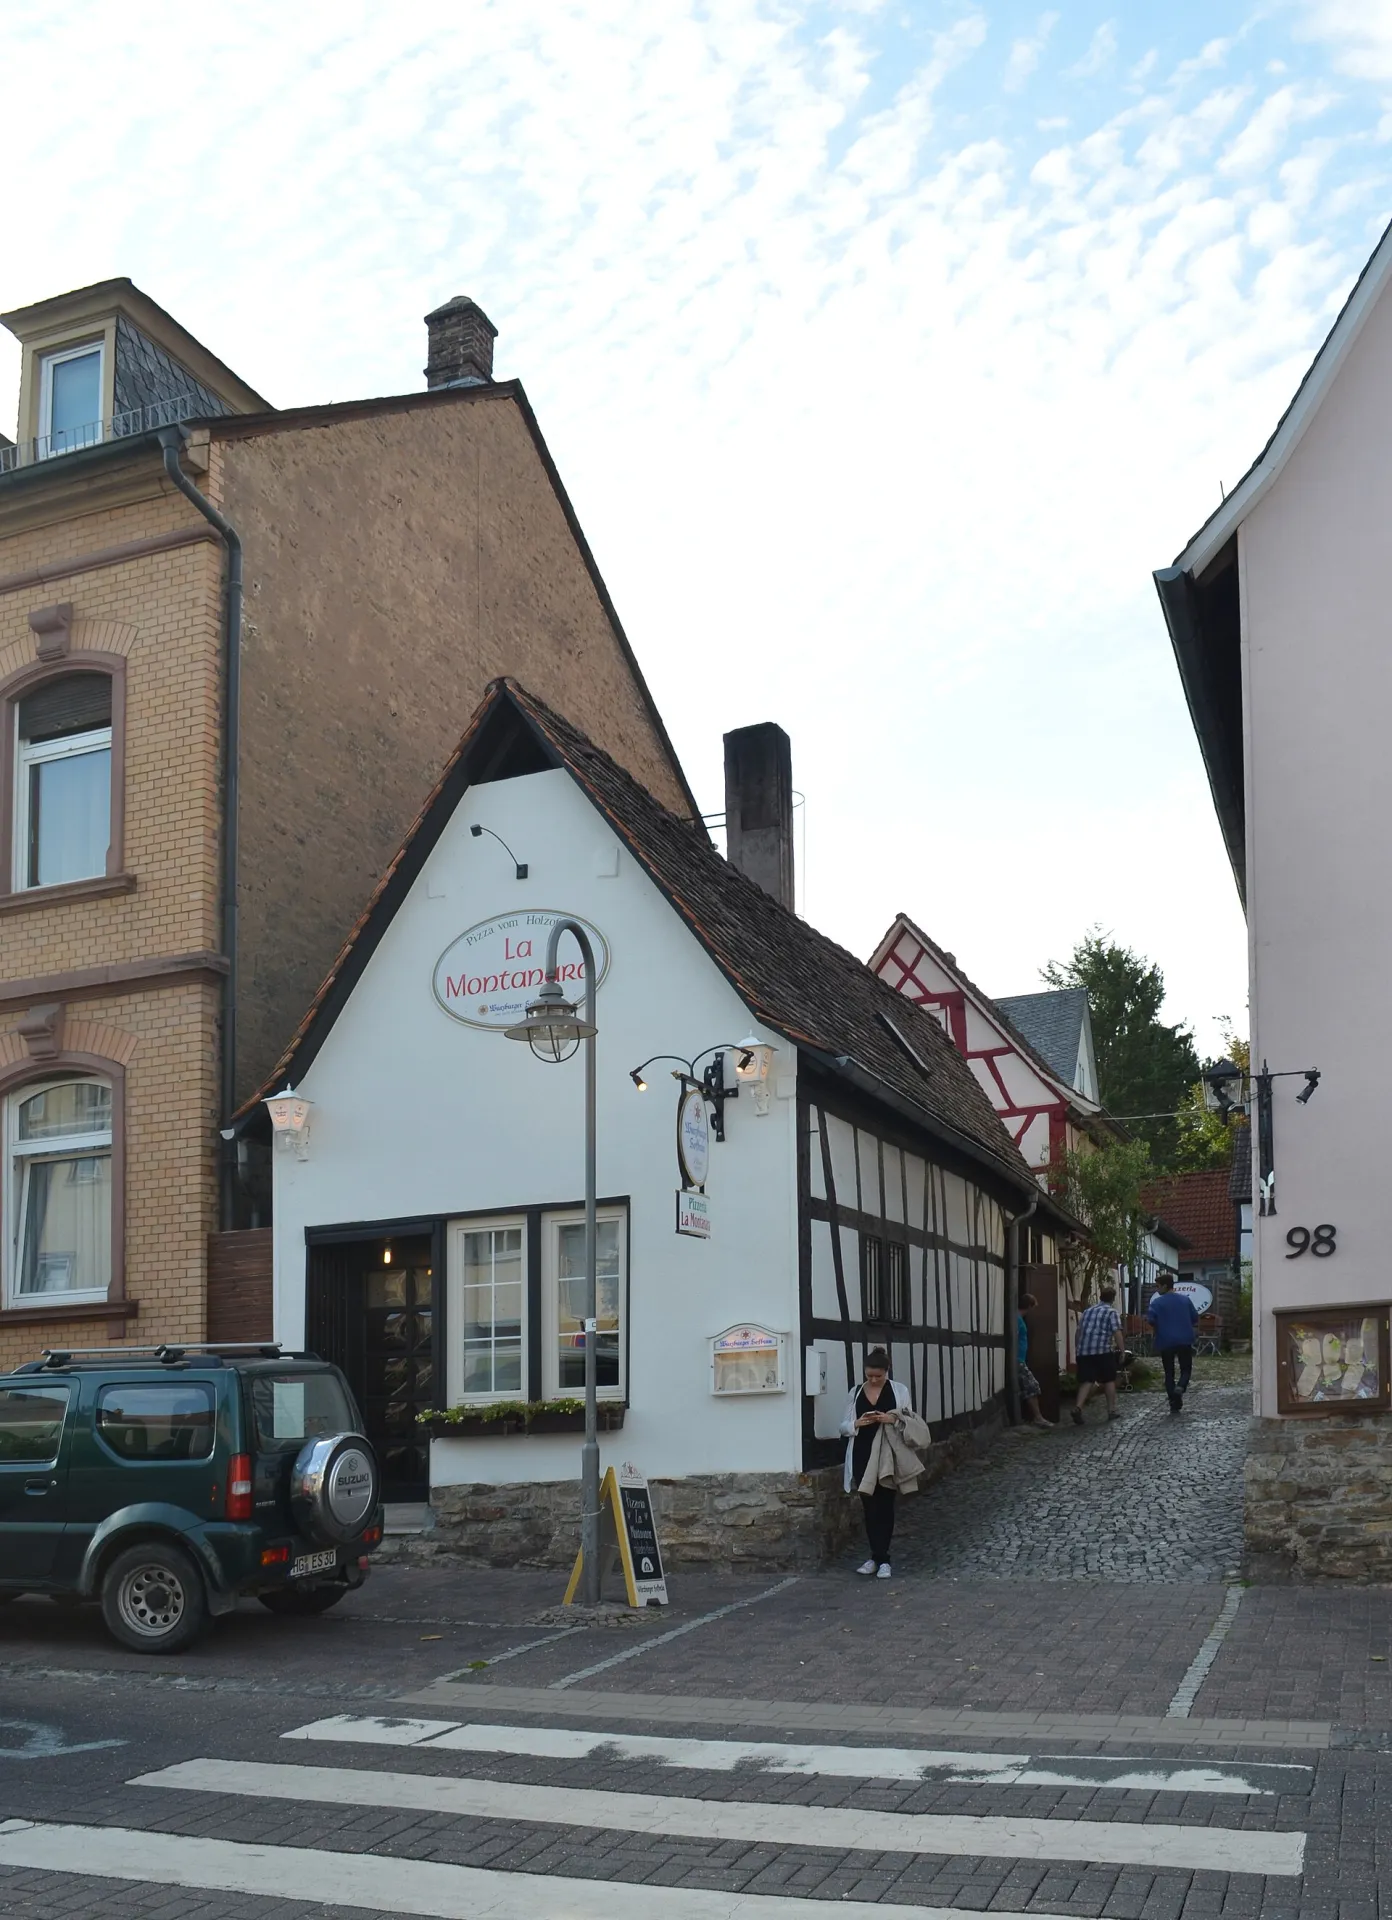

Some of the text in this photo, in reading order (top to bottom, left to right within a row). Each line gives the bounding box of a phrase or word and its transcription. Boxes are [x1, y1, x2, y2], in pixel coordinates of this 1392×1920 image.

[466, 915, 562, 946] Pizza vom Holzof
[505, 938, 532, 960] La
[681, 1211, 689, 1226] La
[1286, 1224, 1337, 1259] 98
[338, 1473, 369, 1486] SUZUKI
[312, 1554, 322, 1569] ES
